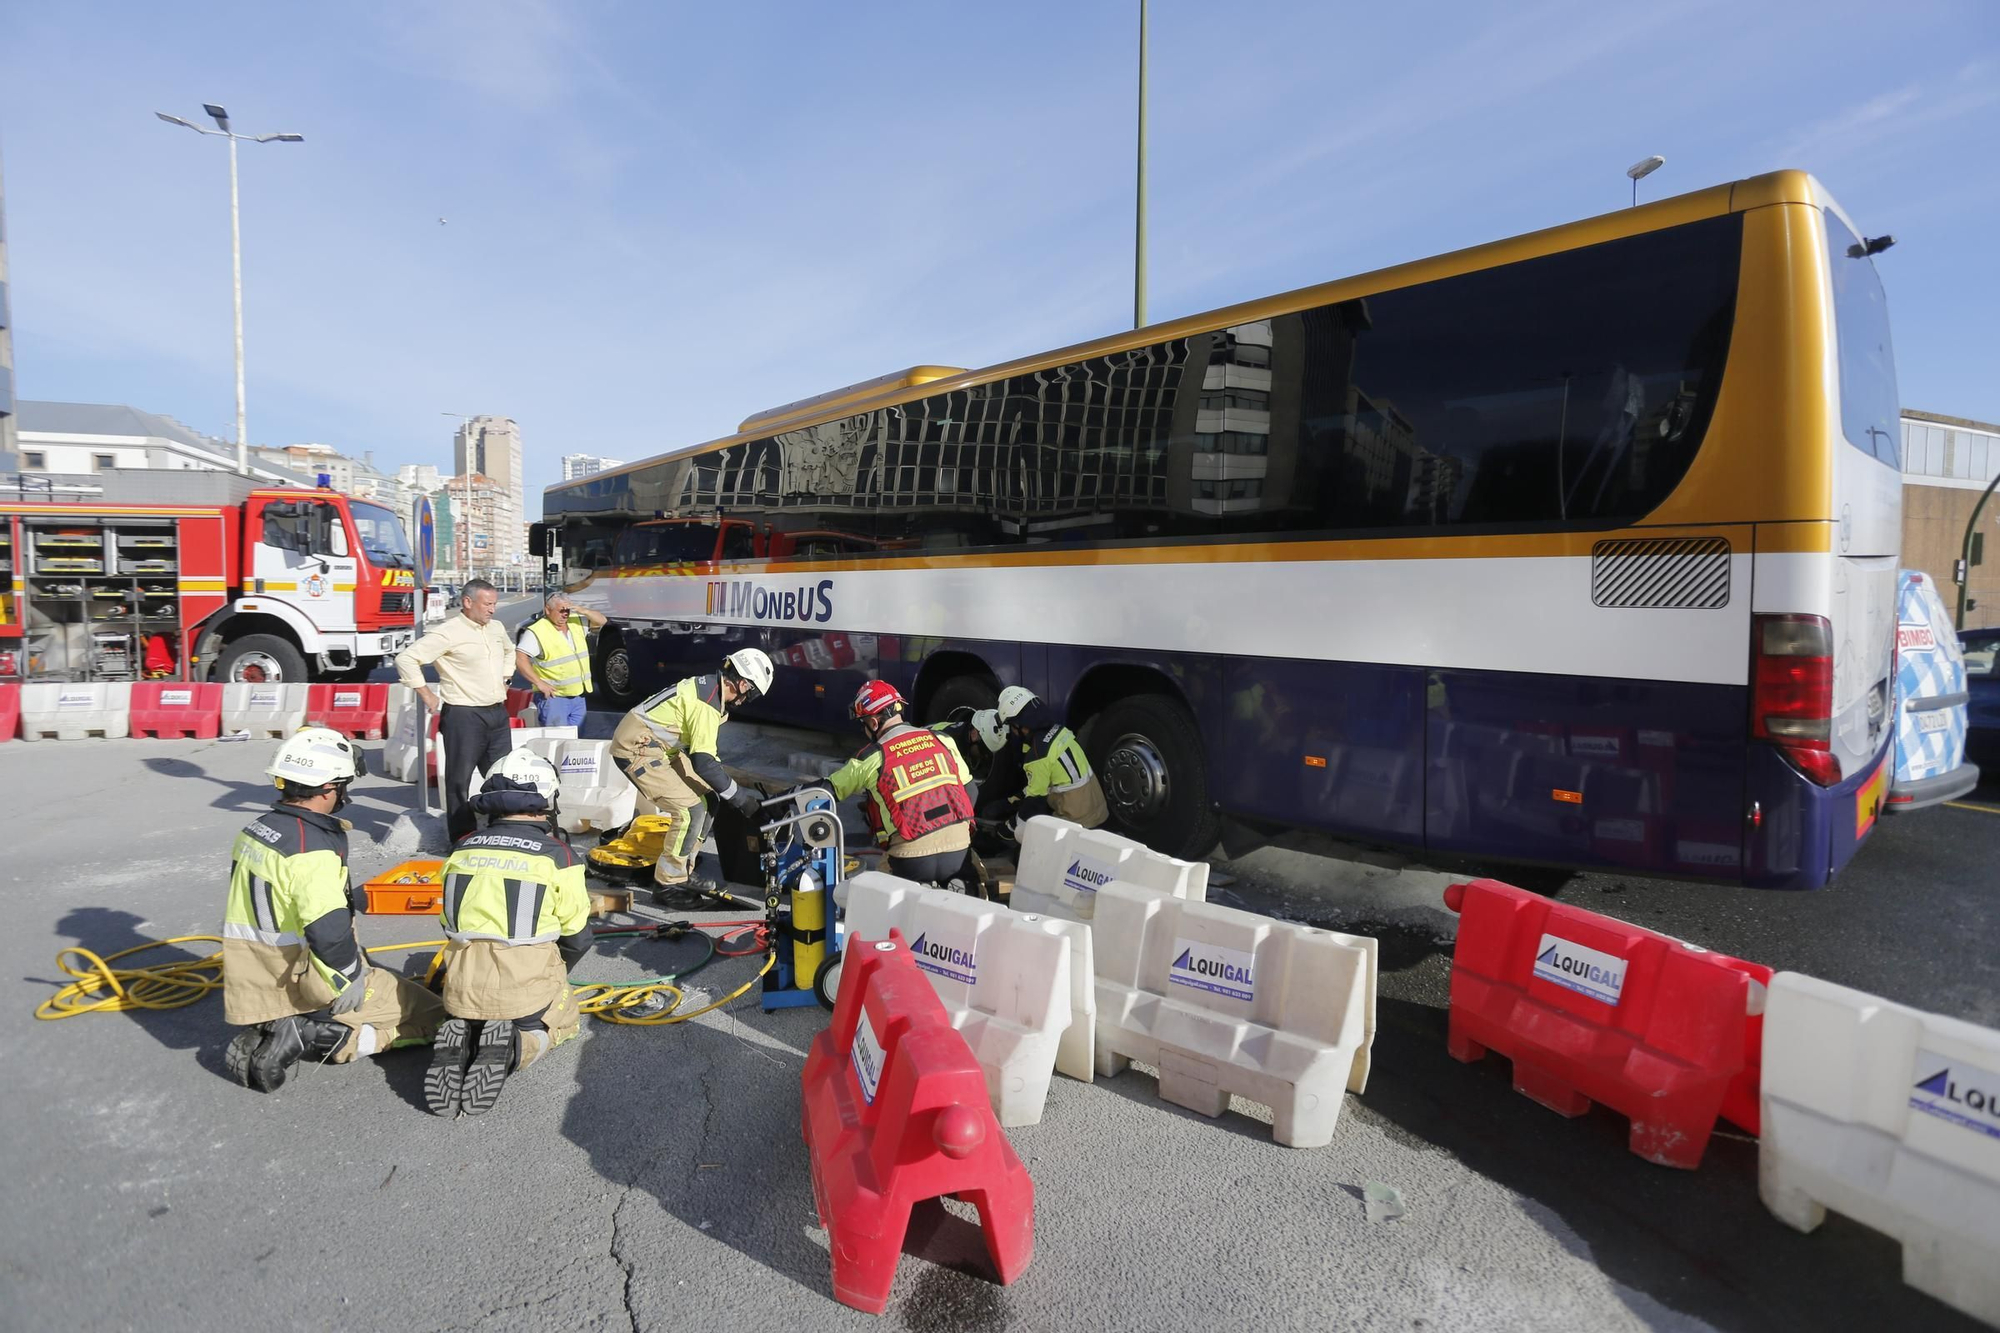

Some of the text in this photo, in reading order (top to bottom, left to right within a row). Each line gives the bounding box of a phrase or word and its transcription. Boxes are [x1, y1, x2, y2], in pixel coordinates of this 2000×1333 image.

[889, 734, 934, 752] BOMBEIROS
[896, 740, 936, 758] A CORUÑA
[284, 754, 314, 768] B-403
[909, 759, 934, 773] JEFE DE
[511, 773, 540, 783] B-103
[910, 766, 935, 779] EQUIPO
[463, 835, 543, 851] BOMBEIROS
